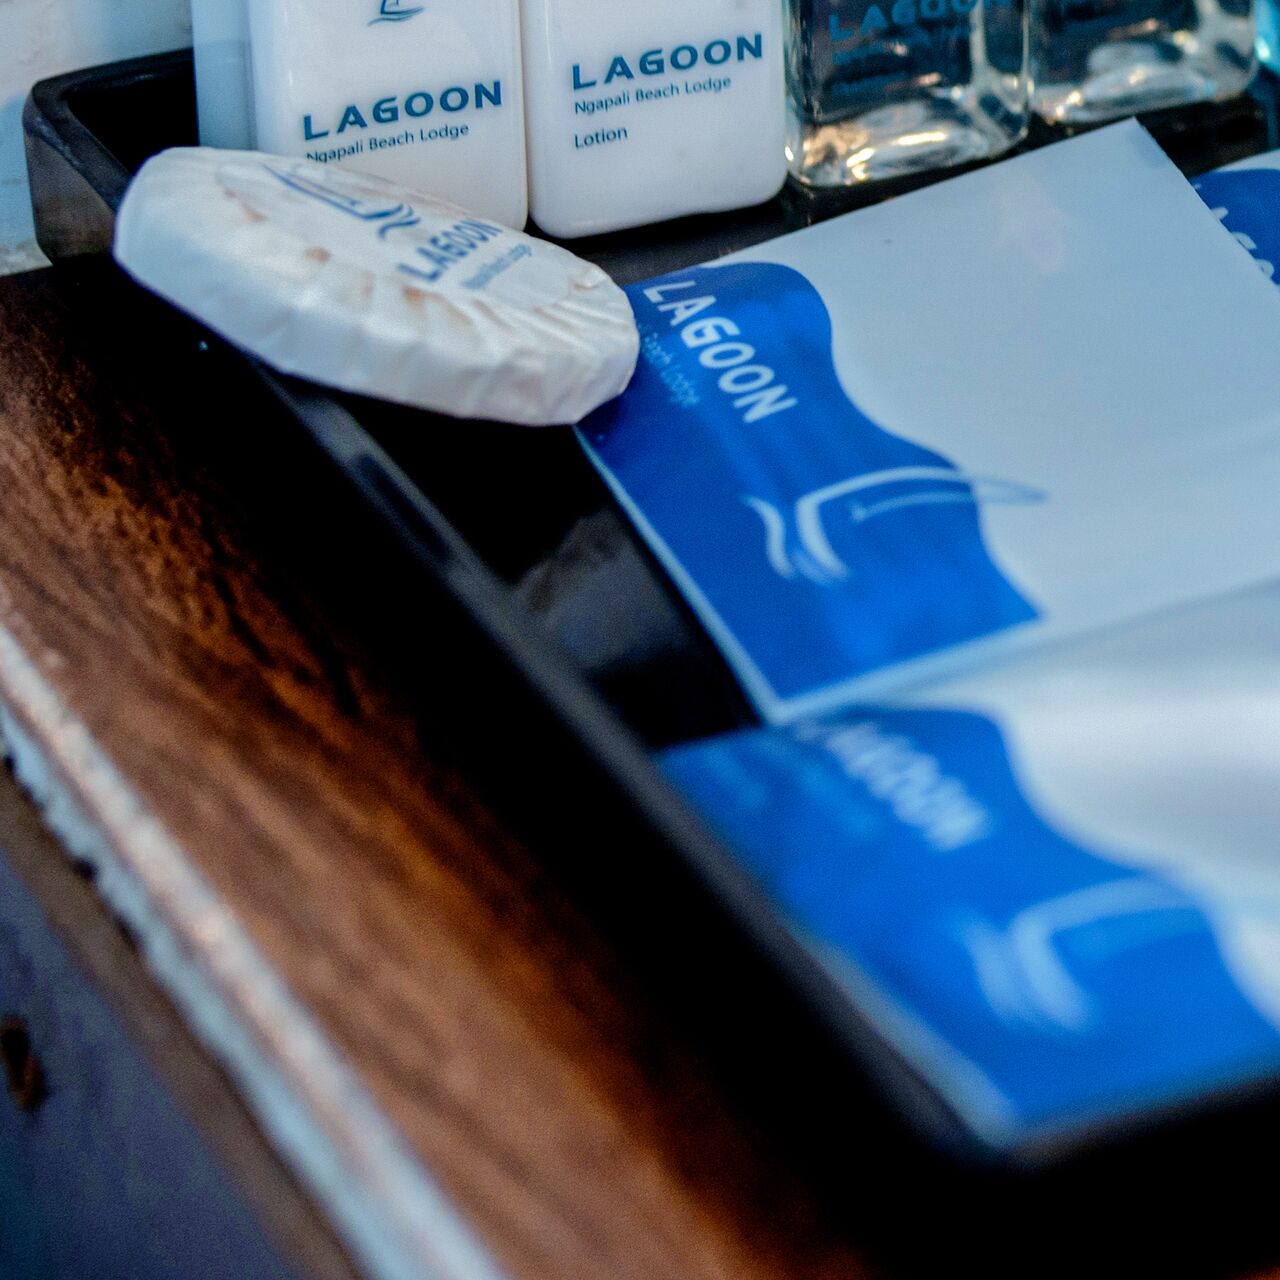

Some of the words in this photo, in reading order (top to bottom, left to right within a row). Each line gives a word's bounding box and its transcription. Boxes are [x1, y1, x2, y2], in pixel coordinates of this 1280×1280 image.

[572, 33, 763, 91] LAGOON
[303, 80, 502, 141] LAGOON
[574, 93, 631, 115] Ngapali
[635, 82, 681, 104] Beach
[684, 75, 732, 95] Lodge
[369, 131, 415, 151] Beach
[419, 122, 470, 142] Lodge
[574, 126, 629, 150] Lotion
[397, 219, 504, 283] LAGOON
[642, 280, 798, 423] LAGOON
